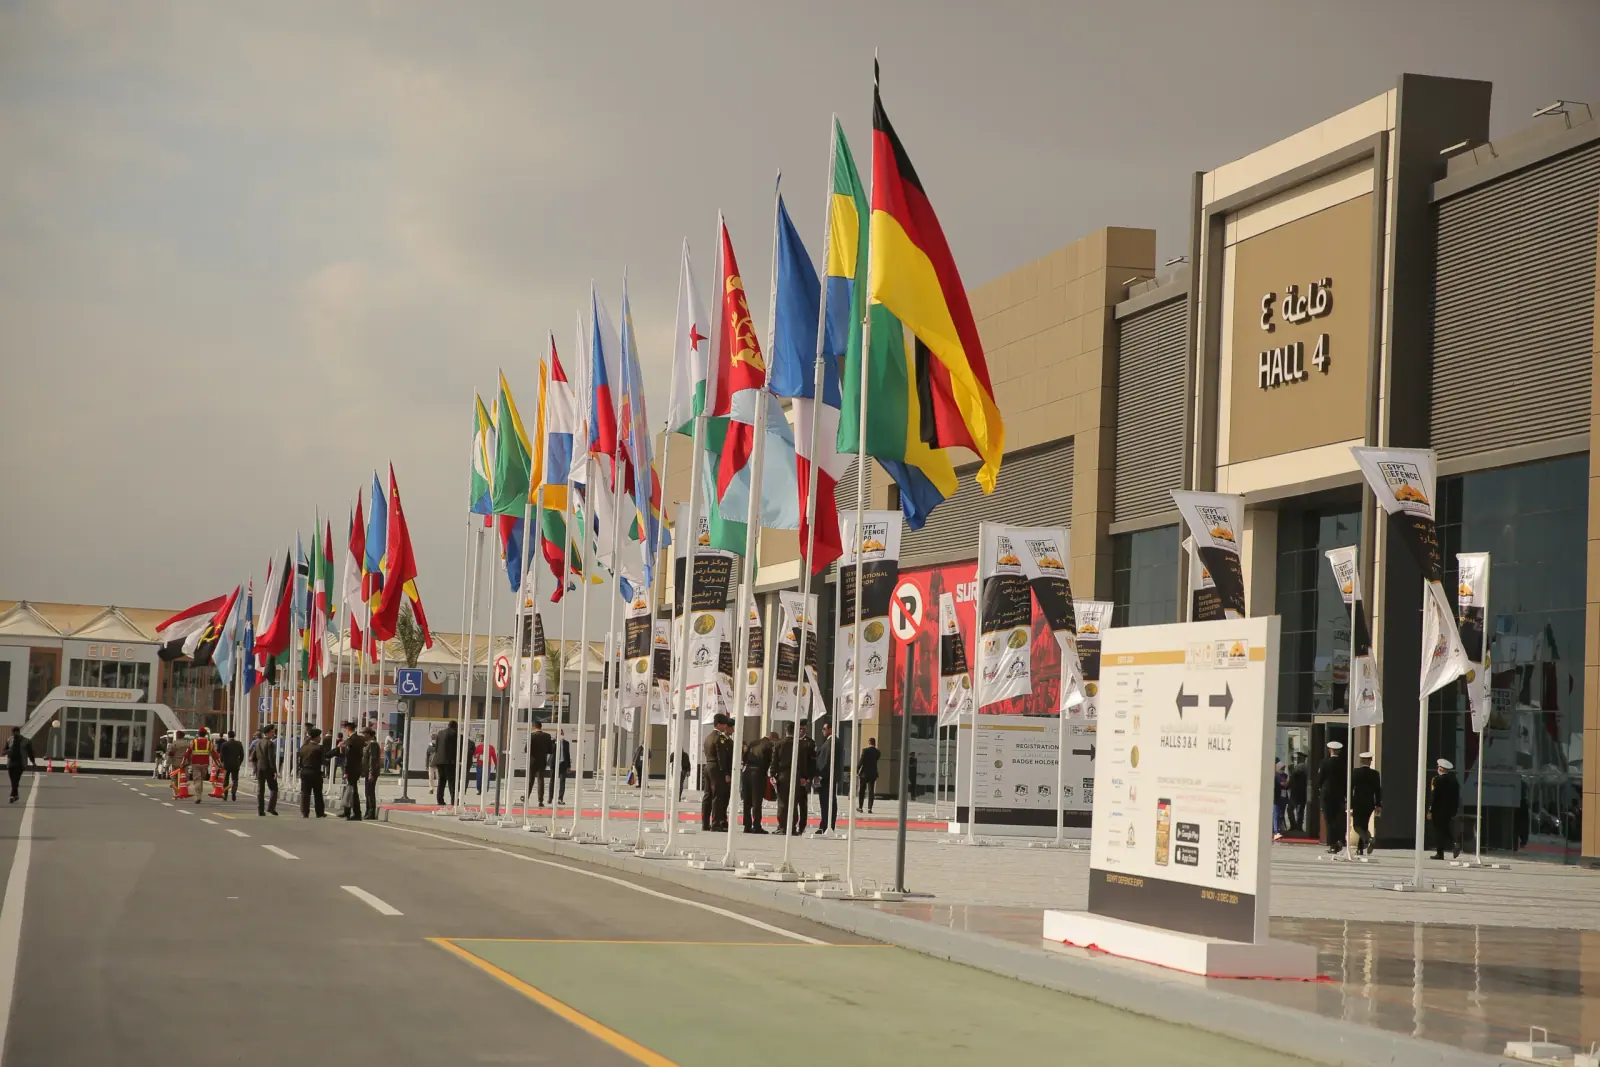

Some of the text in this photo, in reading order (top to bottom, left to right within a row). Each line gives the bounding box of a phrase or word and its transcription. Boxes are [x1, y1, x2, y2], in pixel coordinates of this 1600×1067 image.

[1282, 278, 1332, 324] قاعة
[1259, 334, 1330, 390] HALL 4
[1385, 470, 1419, 480] DEFENCE
[88, 644, 134, 659] EIEC
[1160, 735, 1181, 748] HALLS
[1183, 736, 1187, 748] 3
[1192, 736, 1197, 748] 4
[1208, 737, 1232, 751] HALL 2
